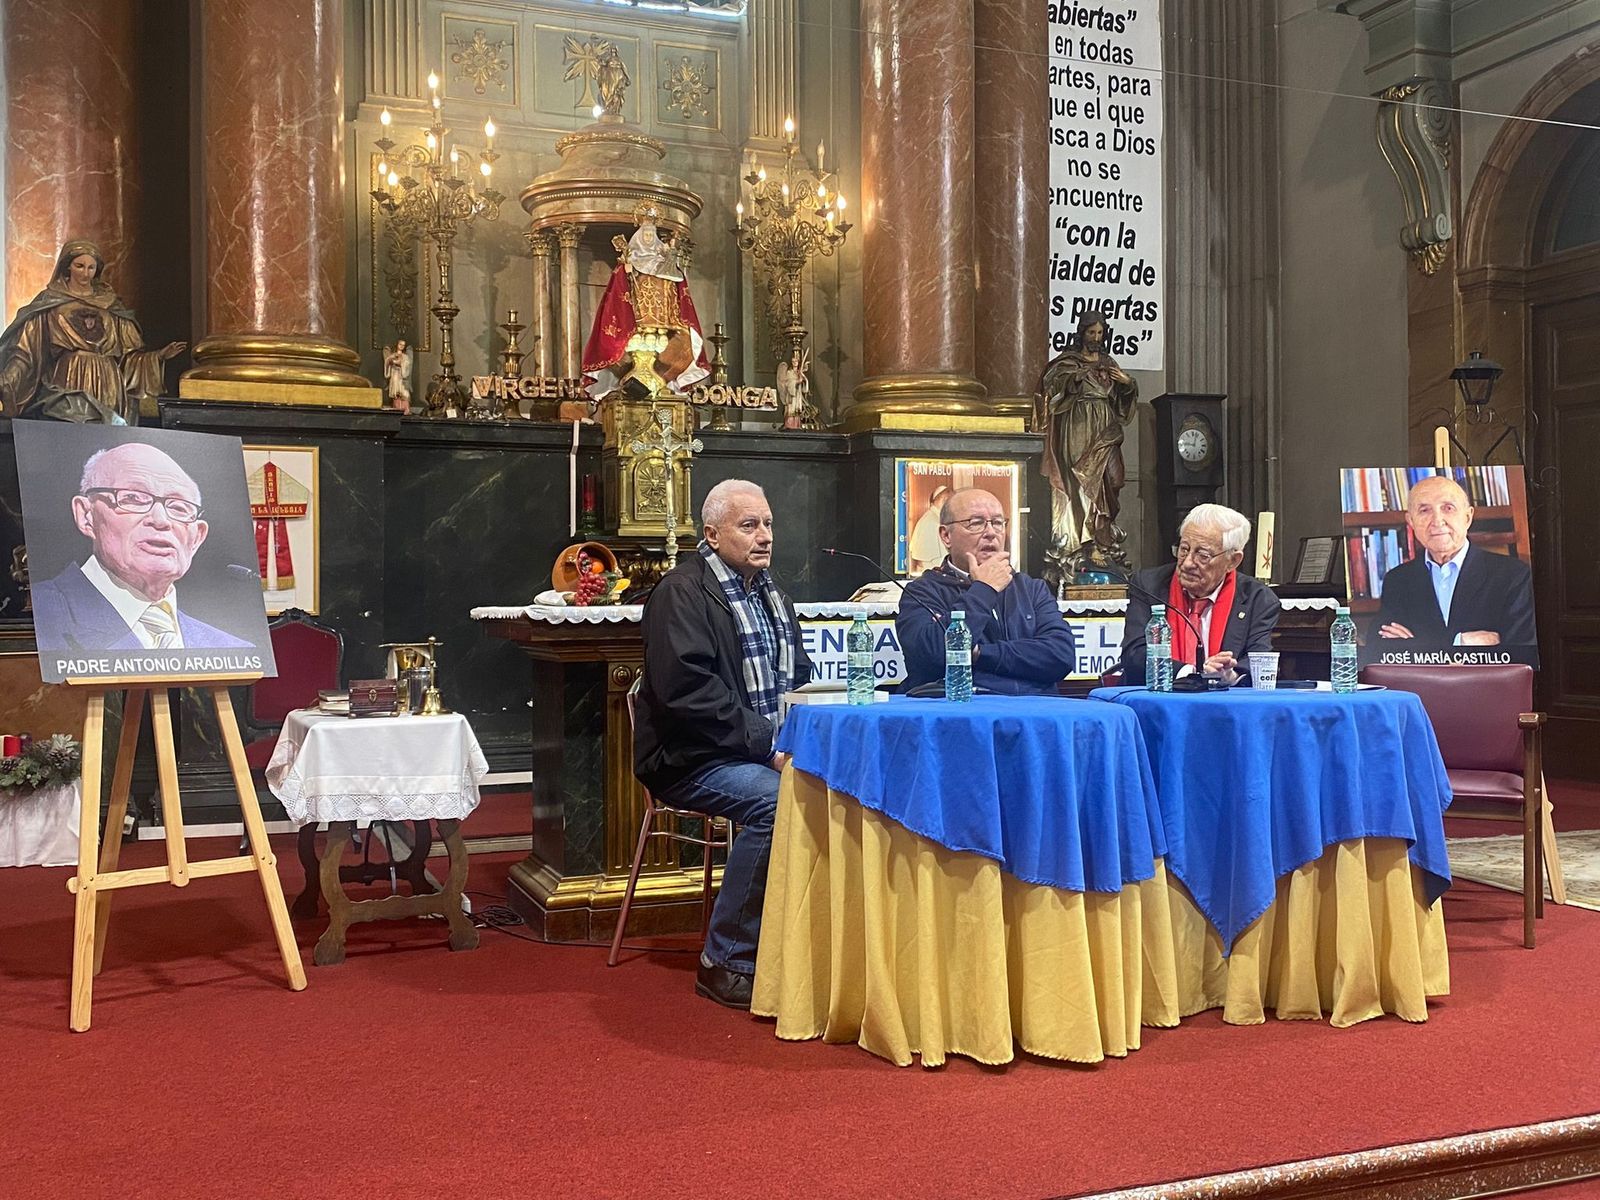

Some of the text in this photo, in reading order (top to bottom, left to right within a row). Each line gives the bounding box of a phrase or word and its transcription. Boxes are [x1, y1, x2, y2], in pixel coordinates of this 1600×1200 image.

[1055, 35, 1134, 65] en todas
[1108, 74, 1151, 98] para
[1084, 97, 1100, 120] el
[1108, 103, 1144, 127] que
[1096, 132, 1106, 150] a
[1113, 128, 1155, 155] Dios
[1068, 158, 1121, 181] no se
[1055, 216, 1136, 249] “con la
[1049, 253, 1156, 286] ialdad de
[1071, 294, 1158, 323] puertas
[472, 376, 575, 400] VIRGEN
[913, 464, 928, 476] SAN
[929, 464, 952, 476] PABLO
[982, 466, 1011, 477] ROMERO
[56, 655, 262, 674] PADRE ANTONIO ARADILLAS
[1380, 650, 1511, 664] JOSÉ MARÍA CASTILLO
